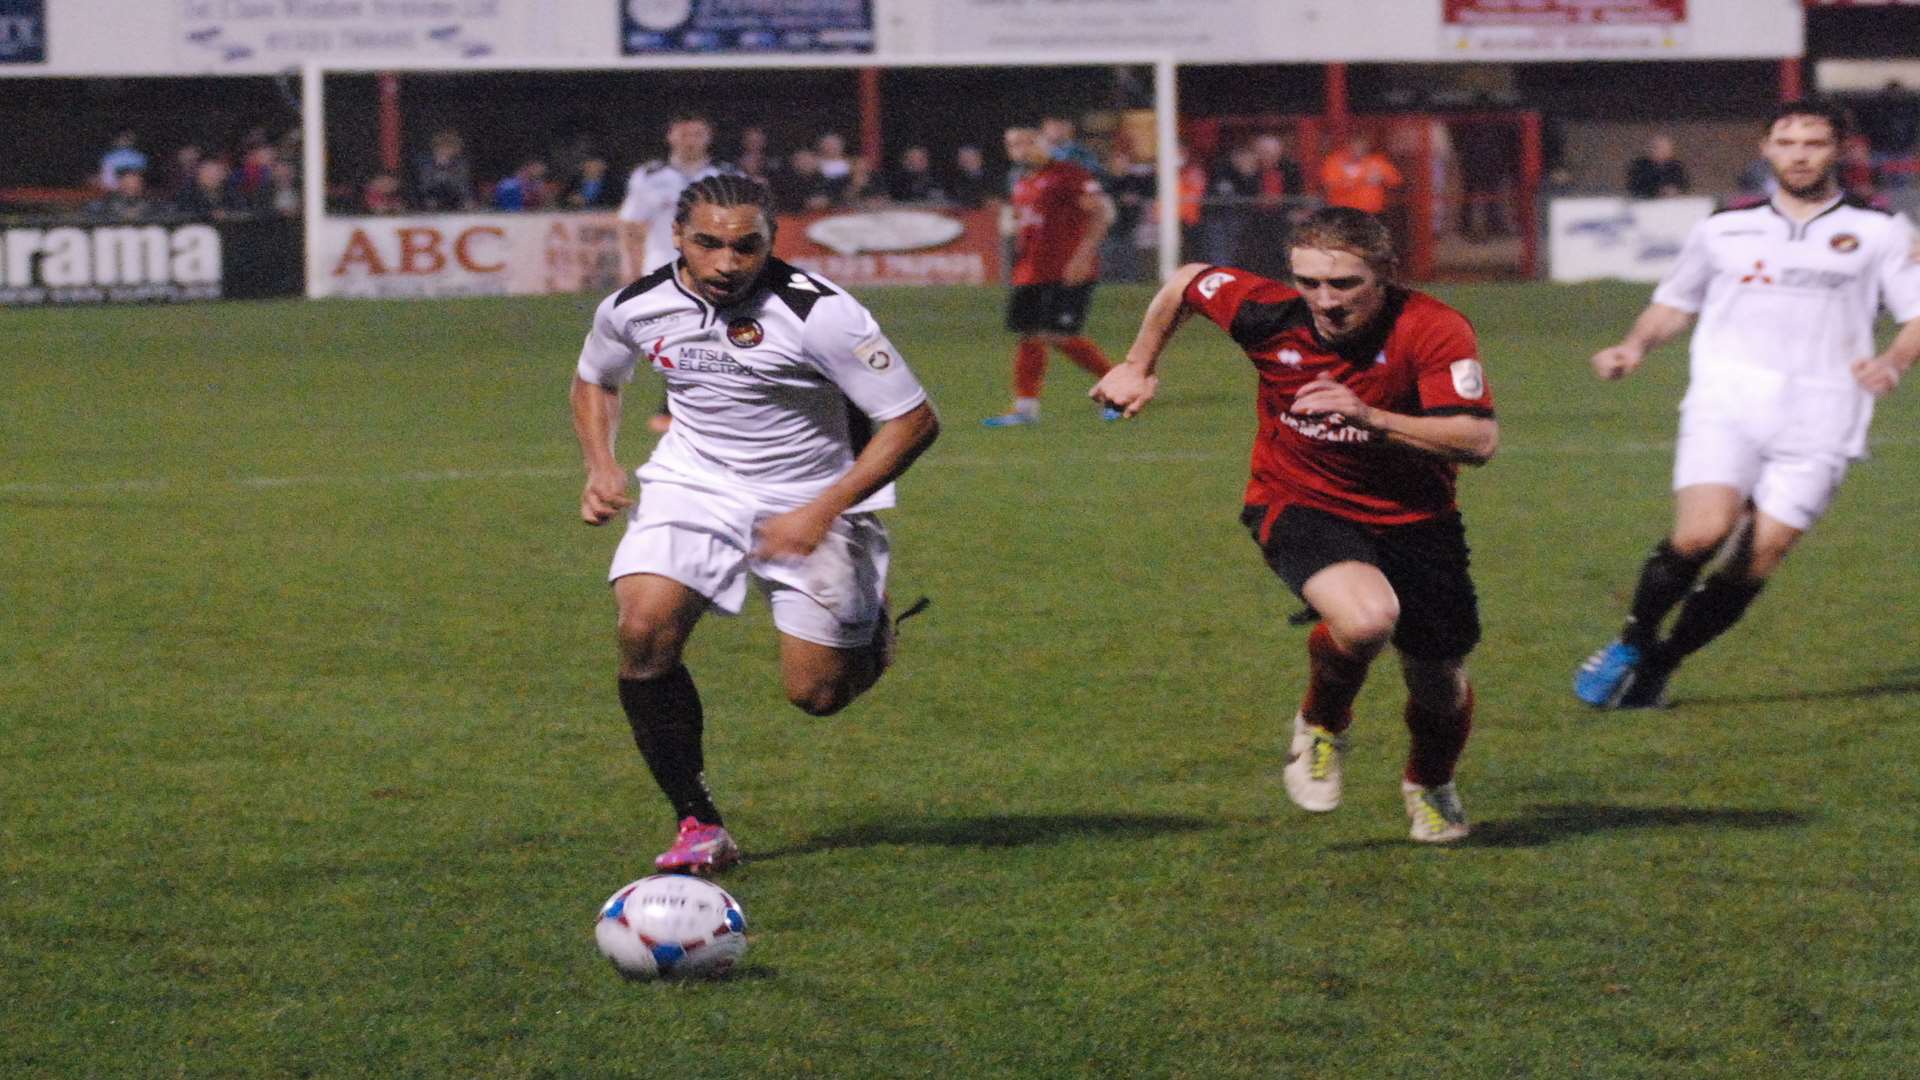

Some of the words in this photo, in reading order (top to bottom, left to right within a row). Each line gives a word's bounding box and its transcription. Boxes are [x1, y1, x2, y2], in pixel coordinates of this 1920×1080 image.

[0, 225, 222, 287] rama
[333, 226, 508, 277] ABC
[679, 346, 740, 363] MITSUB
